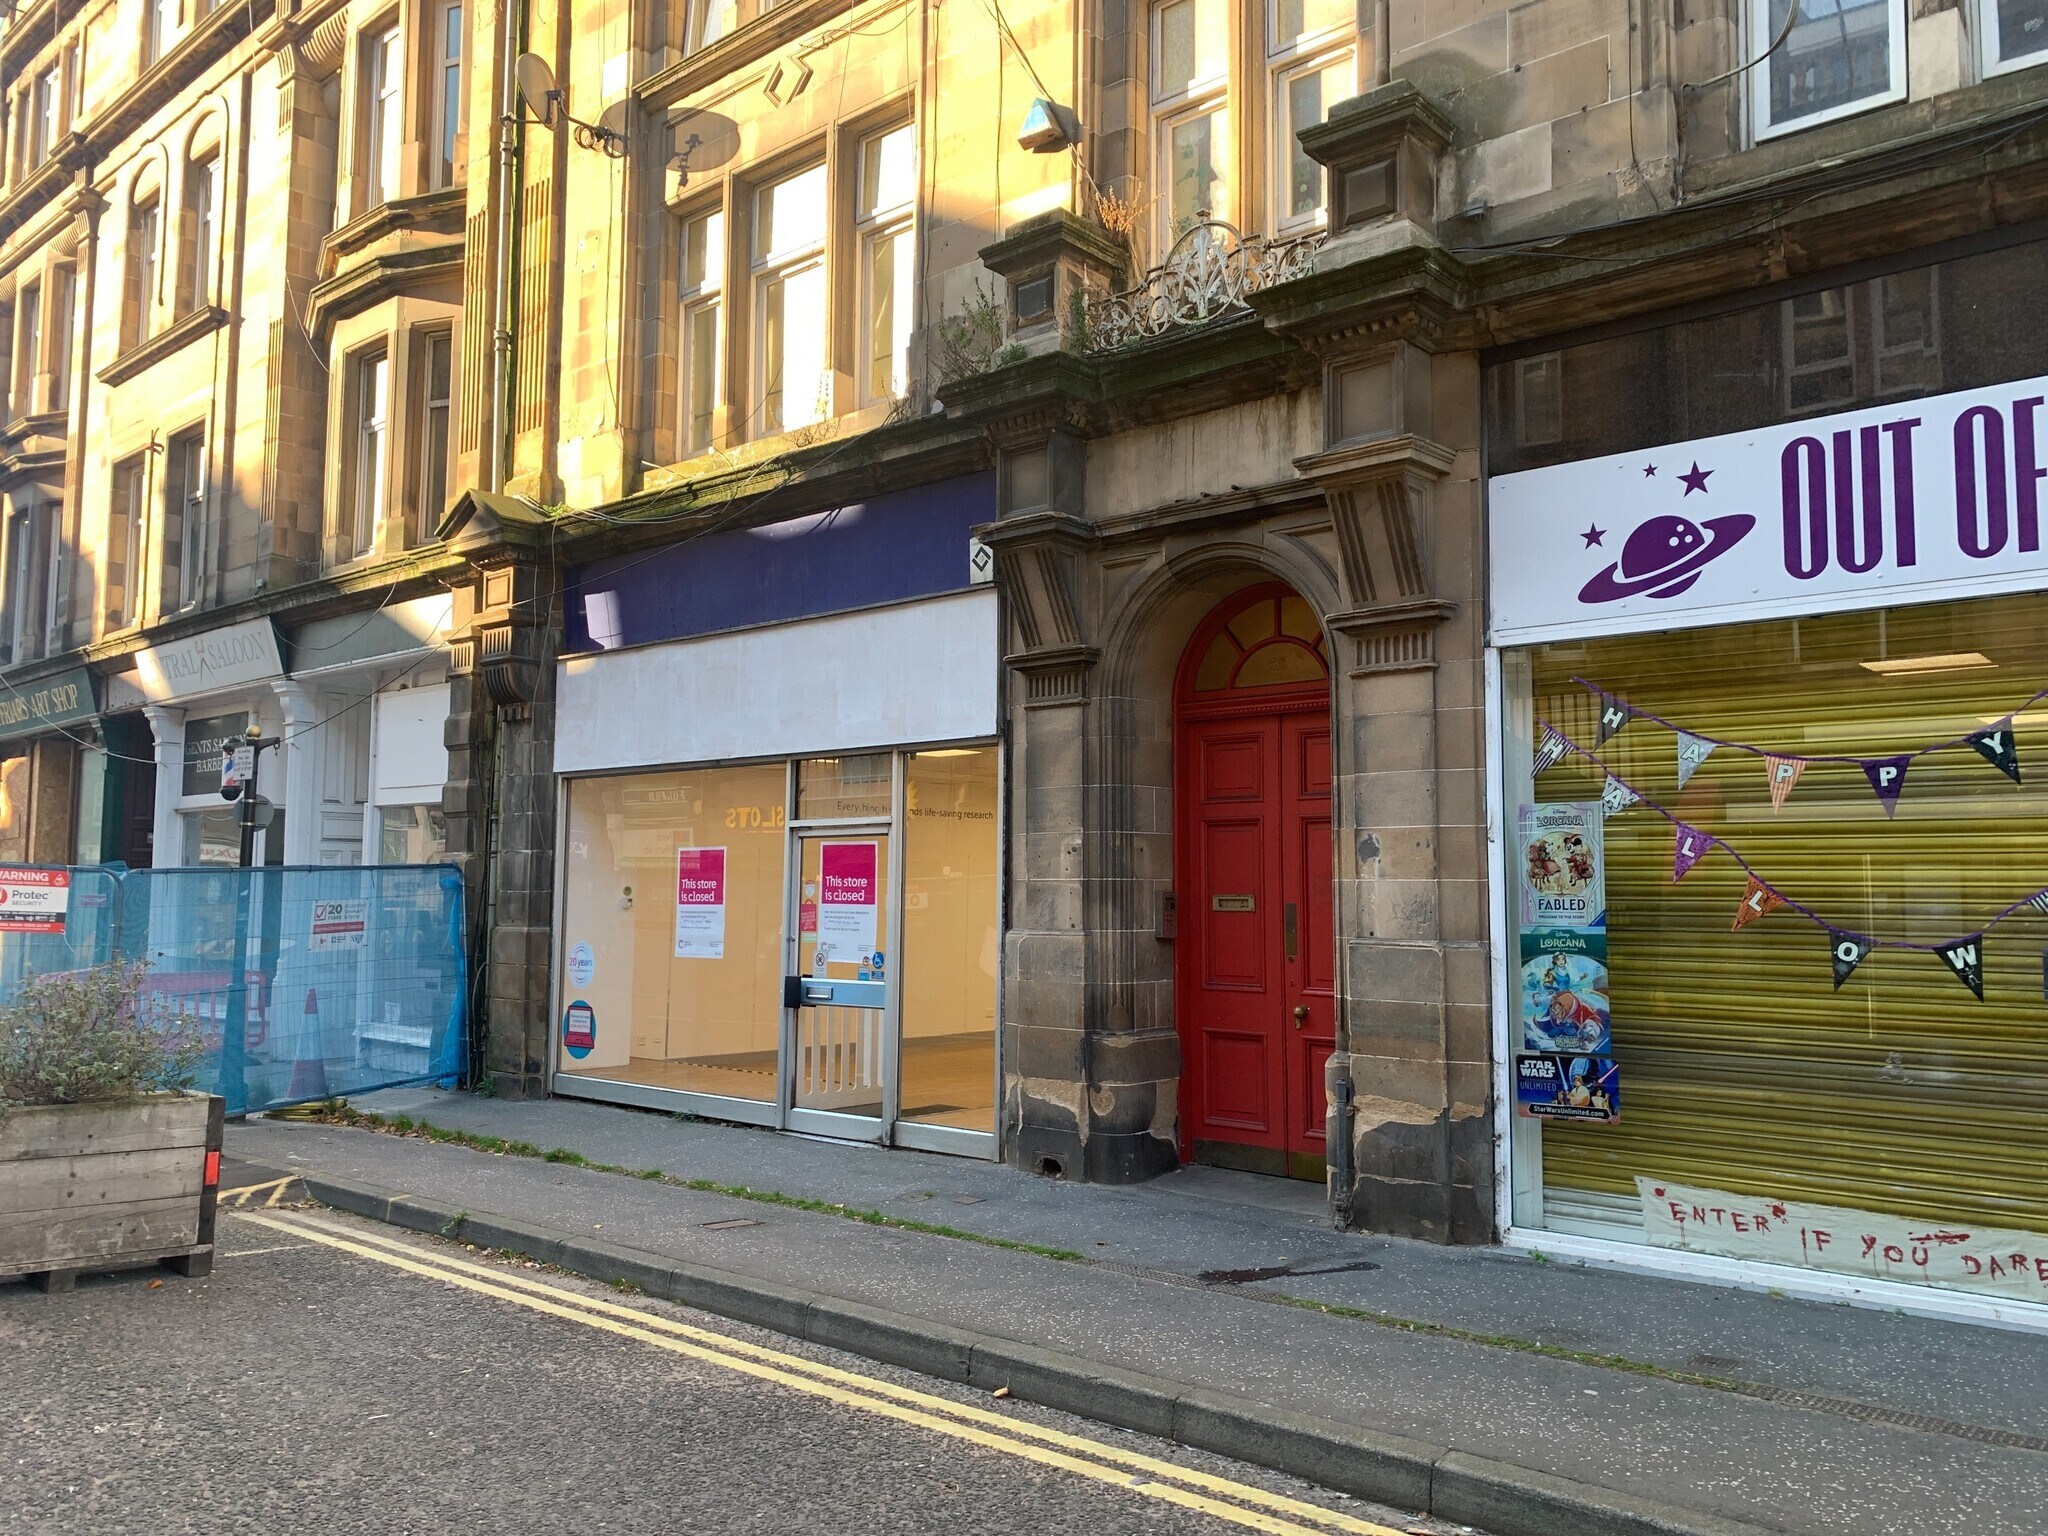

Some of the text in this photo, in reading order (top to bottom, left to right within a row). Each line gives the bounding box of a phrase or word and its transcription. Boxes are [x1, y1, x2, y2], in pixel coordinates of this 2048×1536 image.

[1781, 395, 2048, 580] OUT OF
[208, 632, 267, 669] SALOON
[31, 691, 50, 718] ART
[51, 684, 78, 713] SHOP
[186, 739, 211, 755] GENTS
[924, 808, 962, 820] life-saving
[963, 811, 994, 820] research
[1536, 815, 1585, 828] LORCANA
[681, 879, 717, 889] This store
[825, 875, 867, 887] This store
[12, 890, 49, 900] Protec
[681, 891, 715, 902] is closed
[825, 889, 865, 901] is closed
[328, 904, 343, 915] 20
[1538, 898, 1586, 911] FABLED
[1540, 938, 1586, 949] LORCANA
[569, 958, 593, 969] 20 years
[1520, 1060, 1555, 1070] STAR
[1520, 1068, 1555, 1078] WARS
[1520, 1082, 1557, 1092] UNLIMITED
[1533, 1105, 1605, 1117] StarWarsUnlimited.com
[1669, 1201, 2048, 1282] ENTER IF YOU DARE
